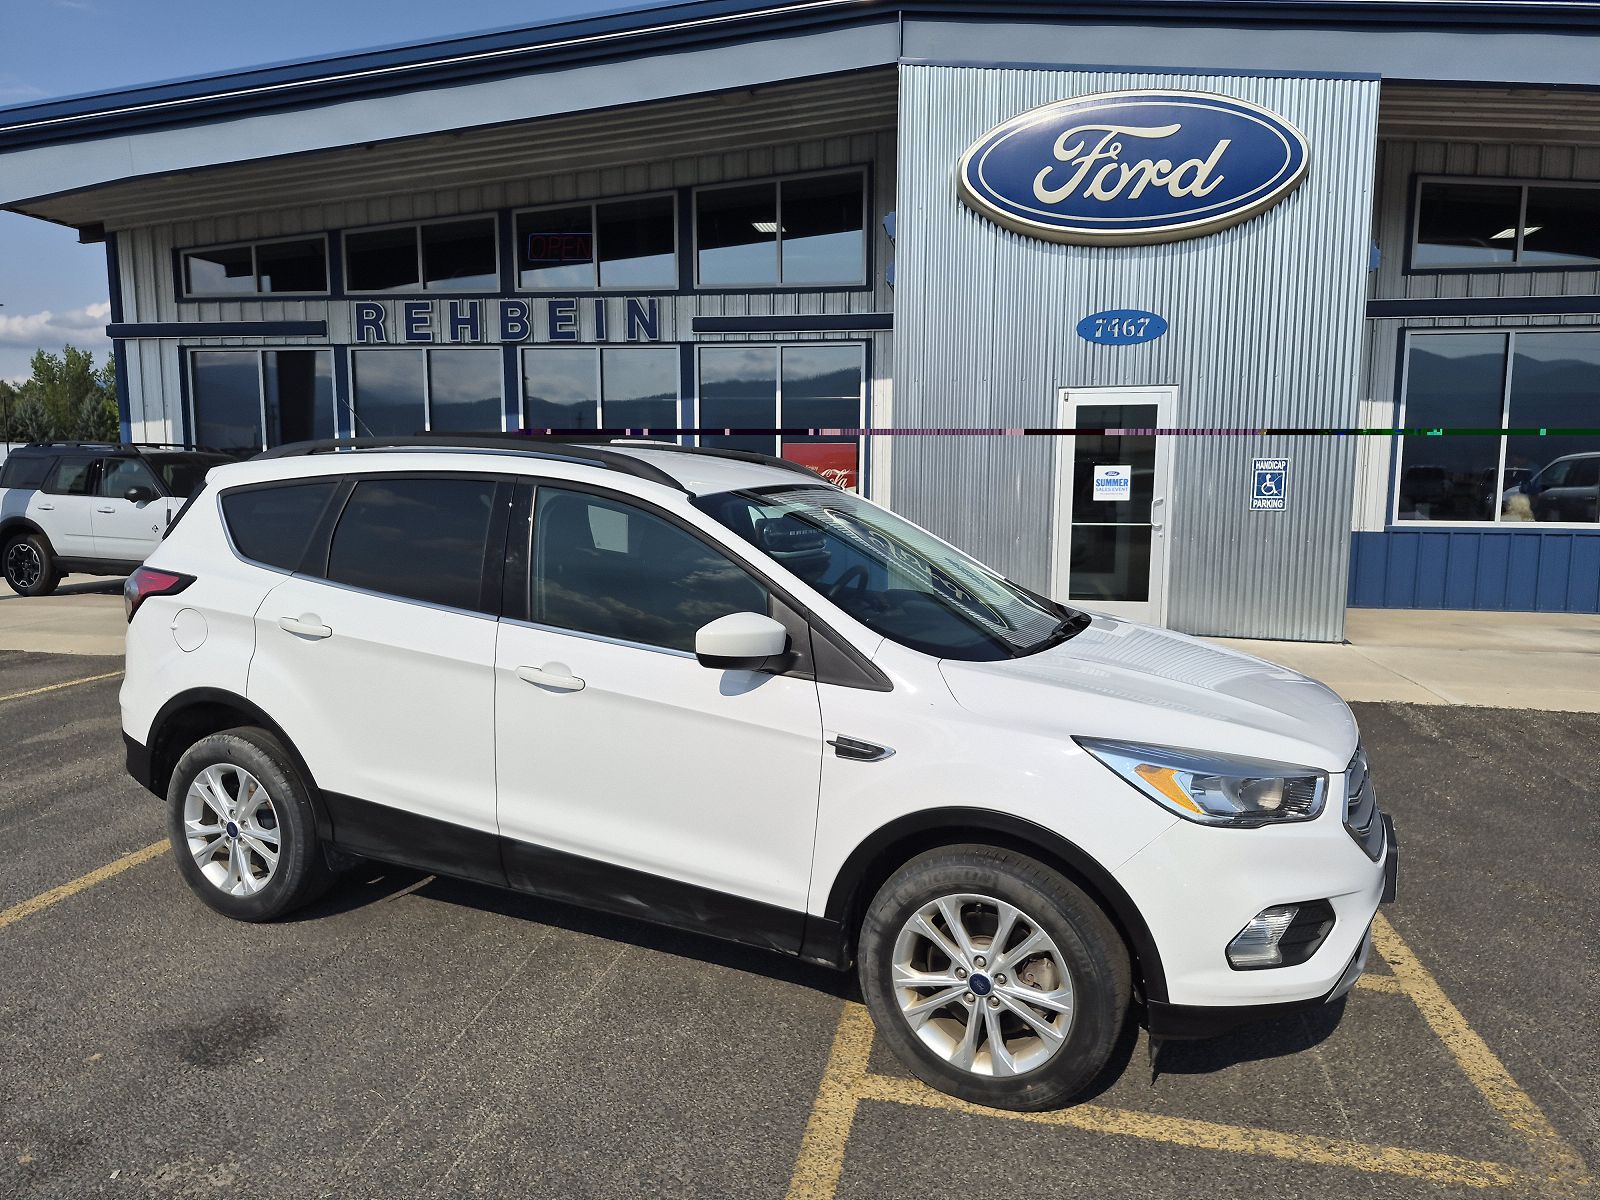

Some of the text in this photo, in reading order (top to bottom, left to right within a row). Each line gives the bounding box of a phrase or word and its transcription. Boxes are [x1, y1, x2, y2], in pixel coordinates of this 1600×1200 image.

[1032, 123, 1232, 205] Ford
[530, 235, 593, 259] OPEN
[354, 297, 660, 343] REHBEIN
[1095, 317, 1151, 338] 7467
[1255, 460, 1287, 470] HANDICAP
[1095, 478, 1129, 487] SUMMER
[1252, 499, 1284, 508] PARKING
